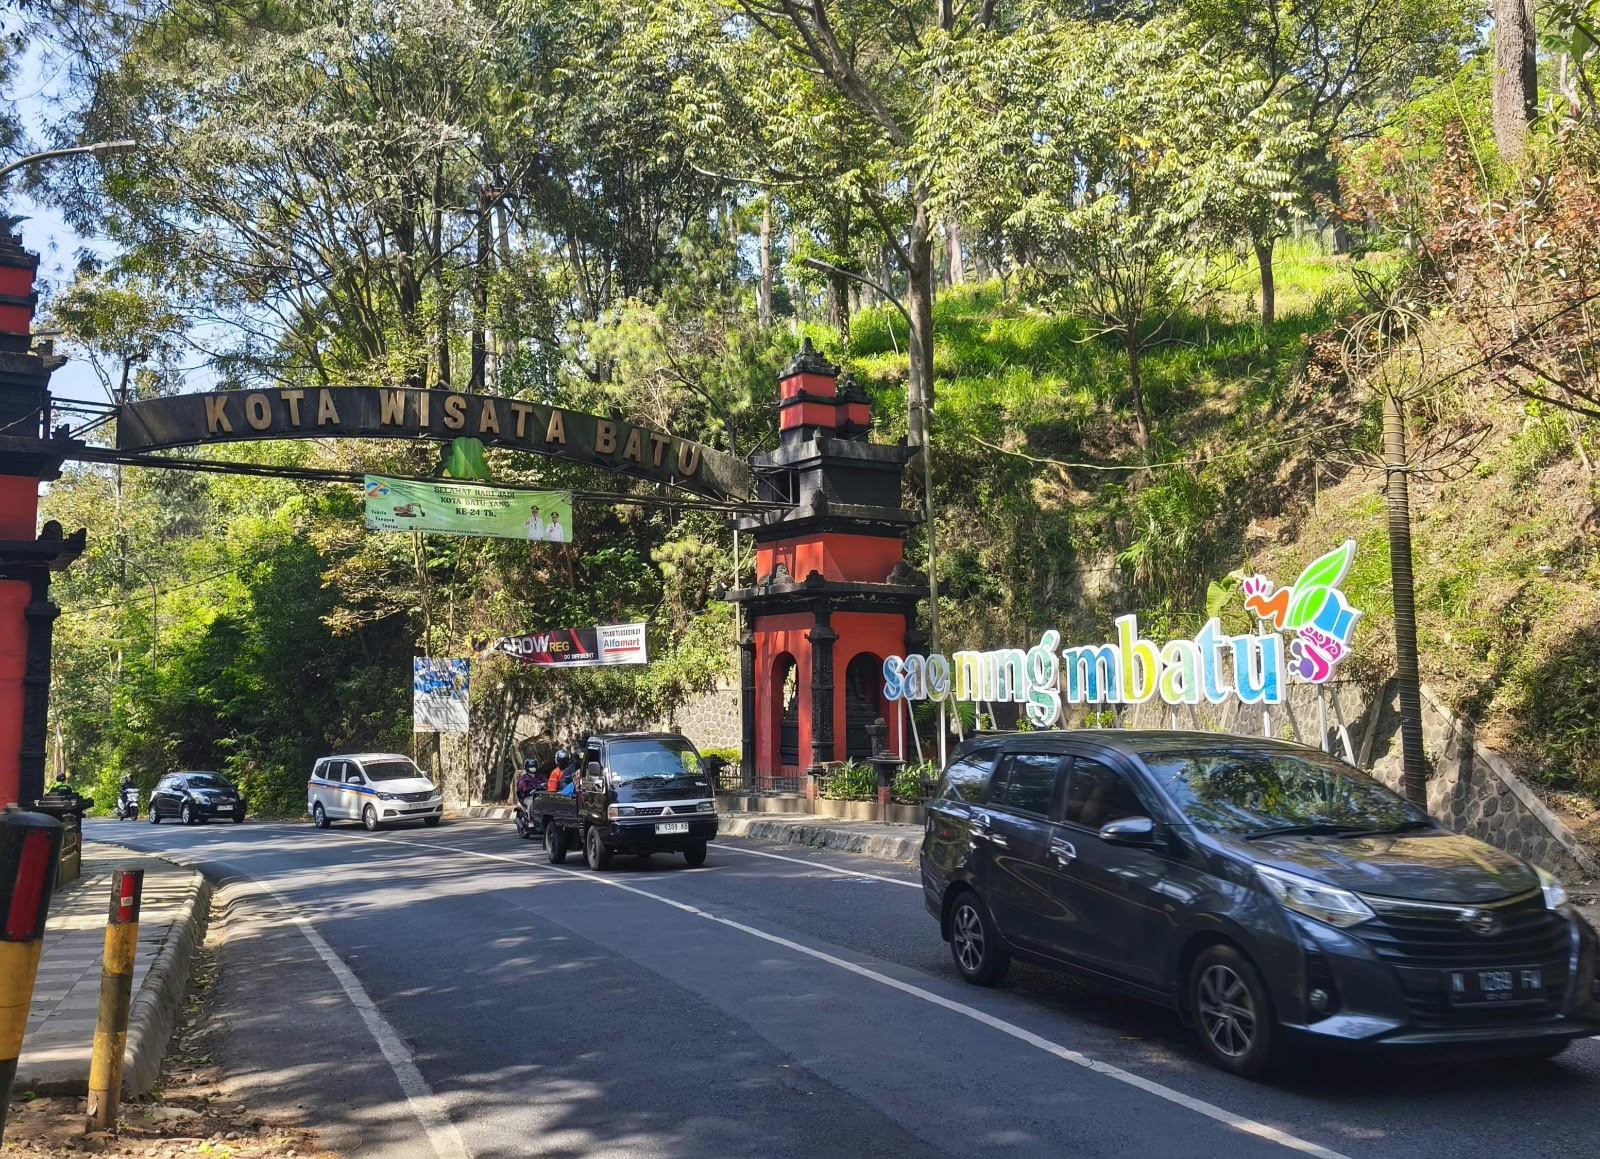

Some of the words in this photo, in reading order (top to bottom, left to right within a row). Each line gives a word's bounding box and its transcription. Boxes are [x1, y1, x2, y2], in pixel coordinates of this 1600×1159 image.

[204, 388, 341, 434] KOTA
[379, 389, 567, 445] WISATA
[594, 419, 703, 477] BATU
[433, 486, 472, 496] SELAMAT
[474, 489, 495, 498] HARI
[497, 491, 515, 499] JADI
[440, 496, 462, 505] KOTA
[465, 498, 486, 507] BATU
[489, 500, 510, 508] YANG
[455, 507, 480, 516] KE-24
[549, 641, 570, 653] REG
[603, 637, 640, 648] Alfamart
[882, 653, 951, 702] sae
[952, 629, 1061, 728] ning
[1062, 614, 1287, 706] mbatu
